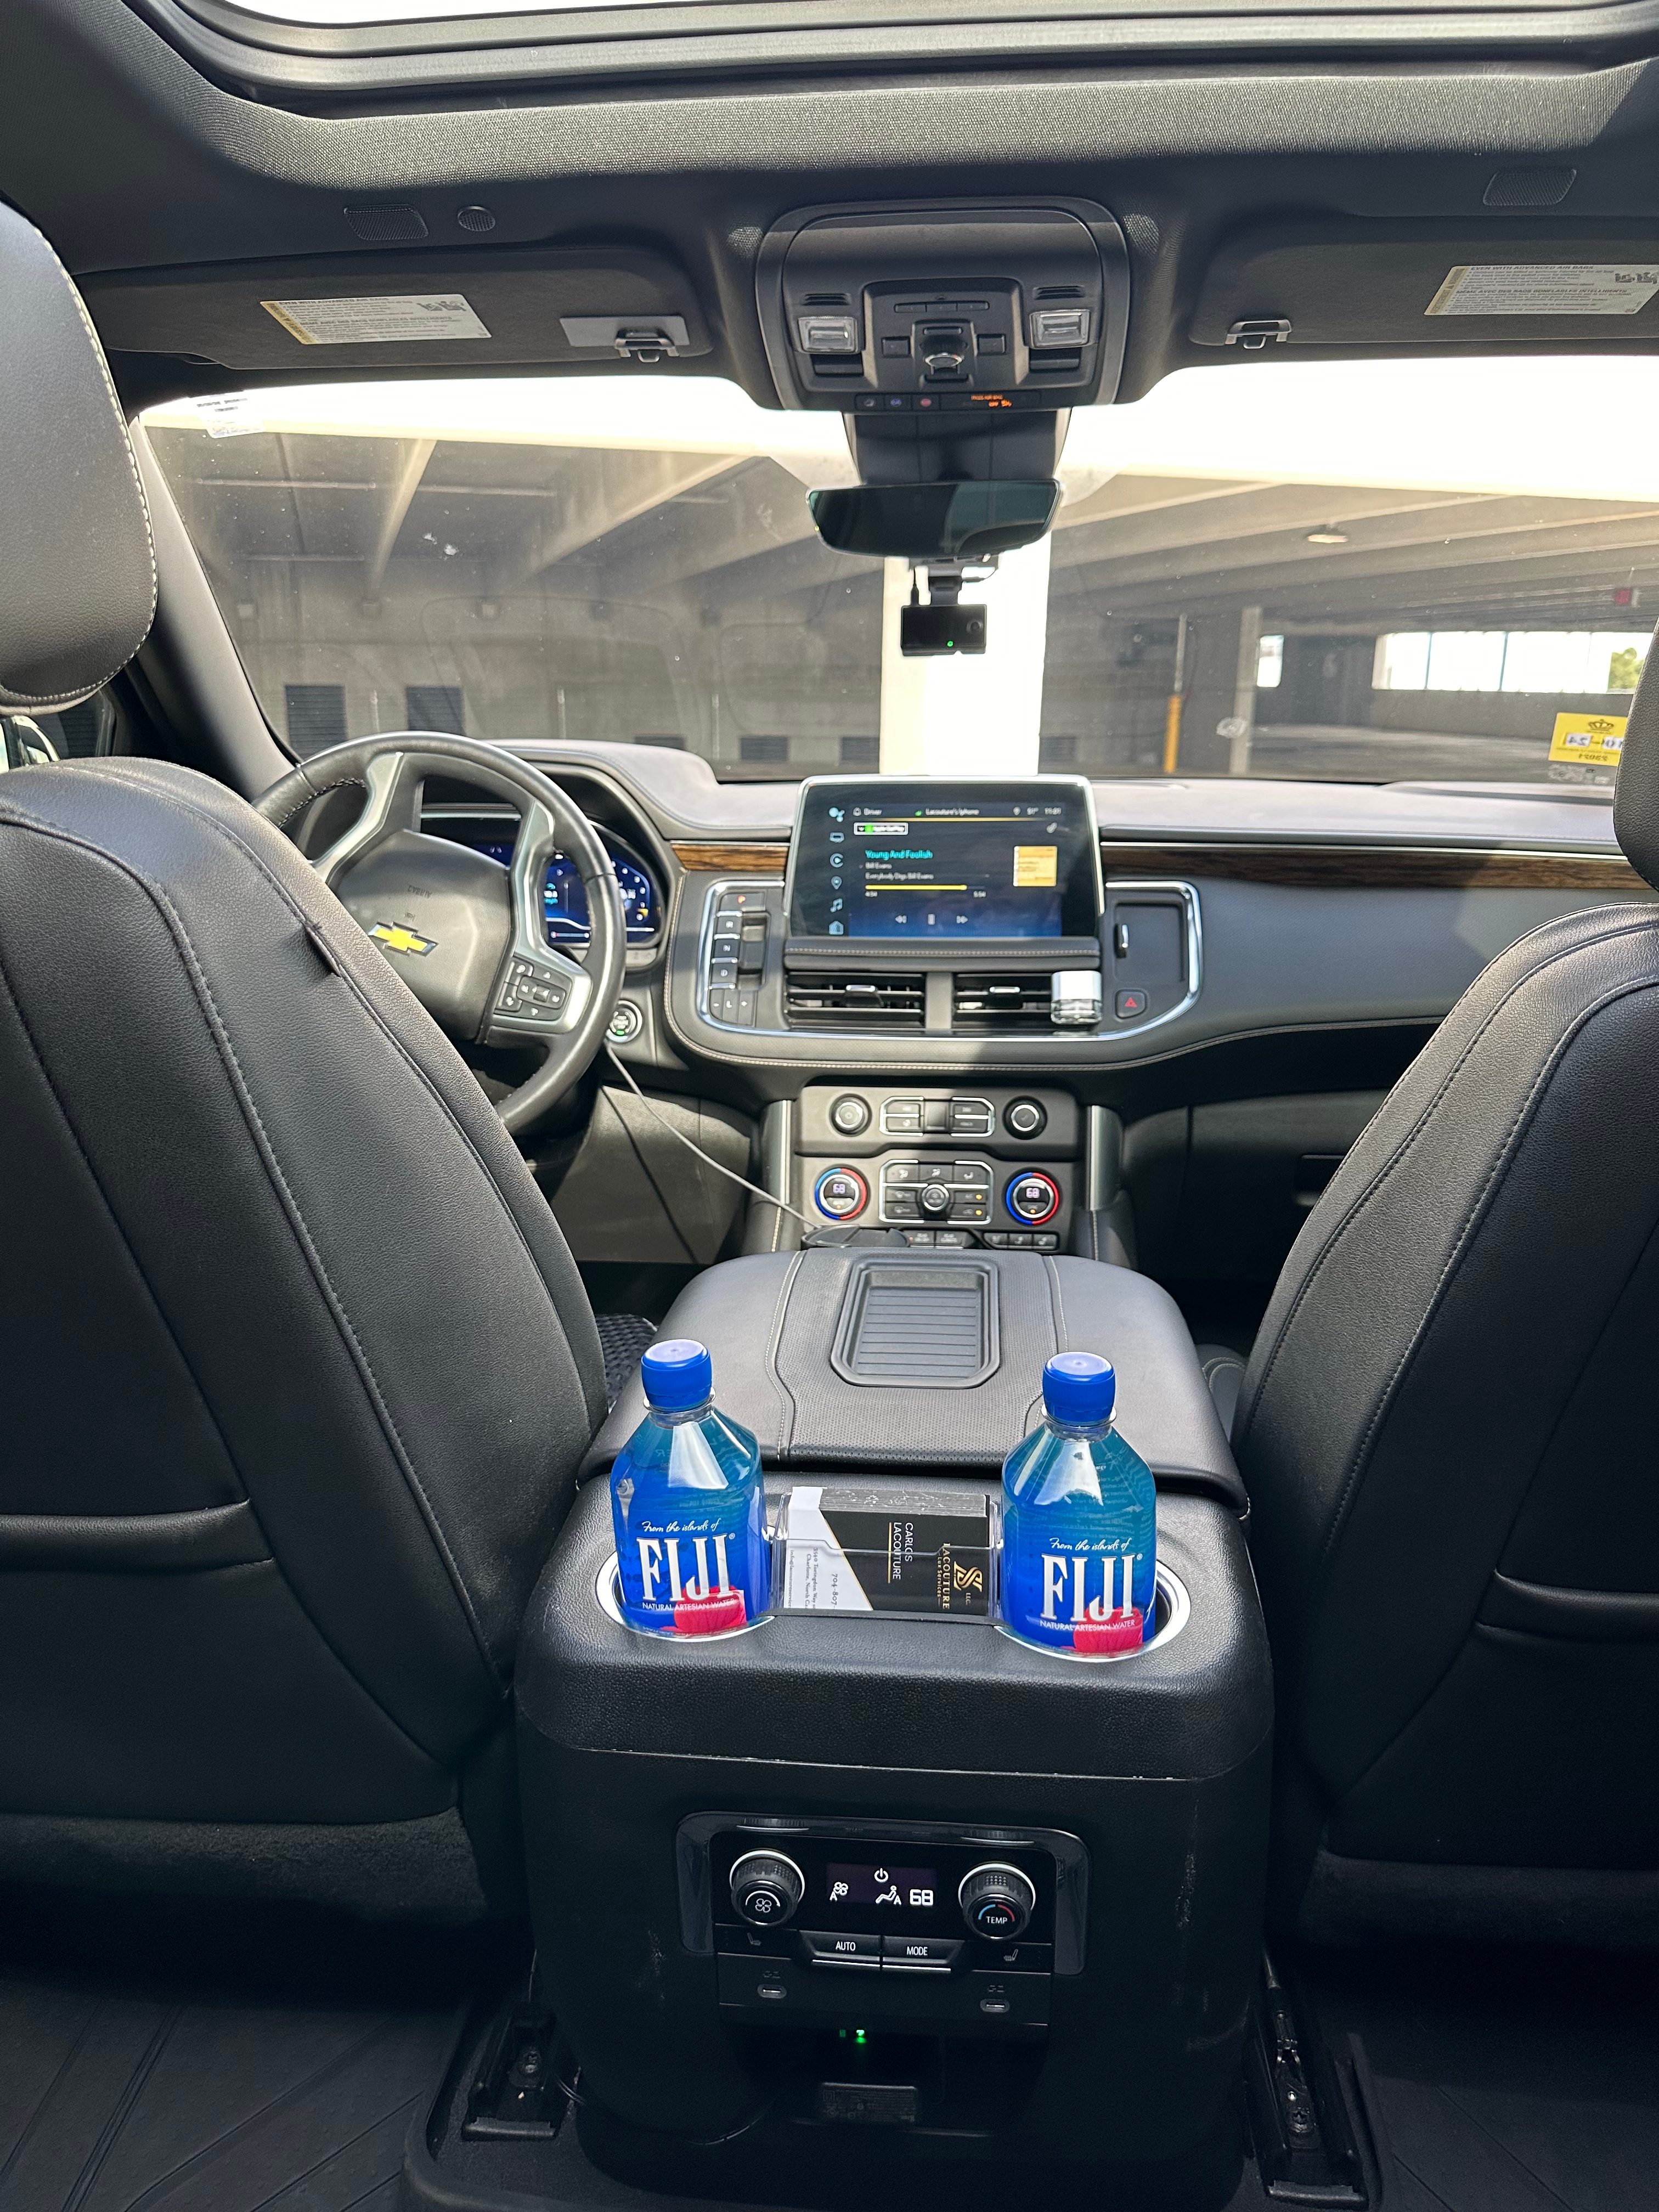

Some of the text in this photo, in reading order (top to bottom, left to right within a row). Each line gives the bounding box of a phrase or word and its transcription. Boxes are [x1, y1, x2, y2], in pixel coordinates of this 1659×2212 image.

[865, 850, 933, 861] Young And Foolish
[642, 1517, 721, 1533] From the islands of
[905, 1522, 914, 1562] CARLOS
[1049, 1537, 1132, 1551] From the islands of
[892, 1522, 902, 1580] LACOUTURE
[642, 1598, 736, 1611] NATURAL ARTESIAN WATER
[1040, 1619, 1135, 1632] NATURAL ARTESIAN WATER
[910, 1889, 934, 1906] 68
[986, 1916, 1008, 1924] TEMP
[836, 1941, 856, 1951] AUTO
[906, 1946, 928, 1956] MODE
